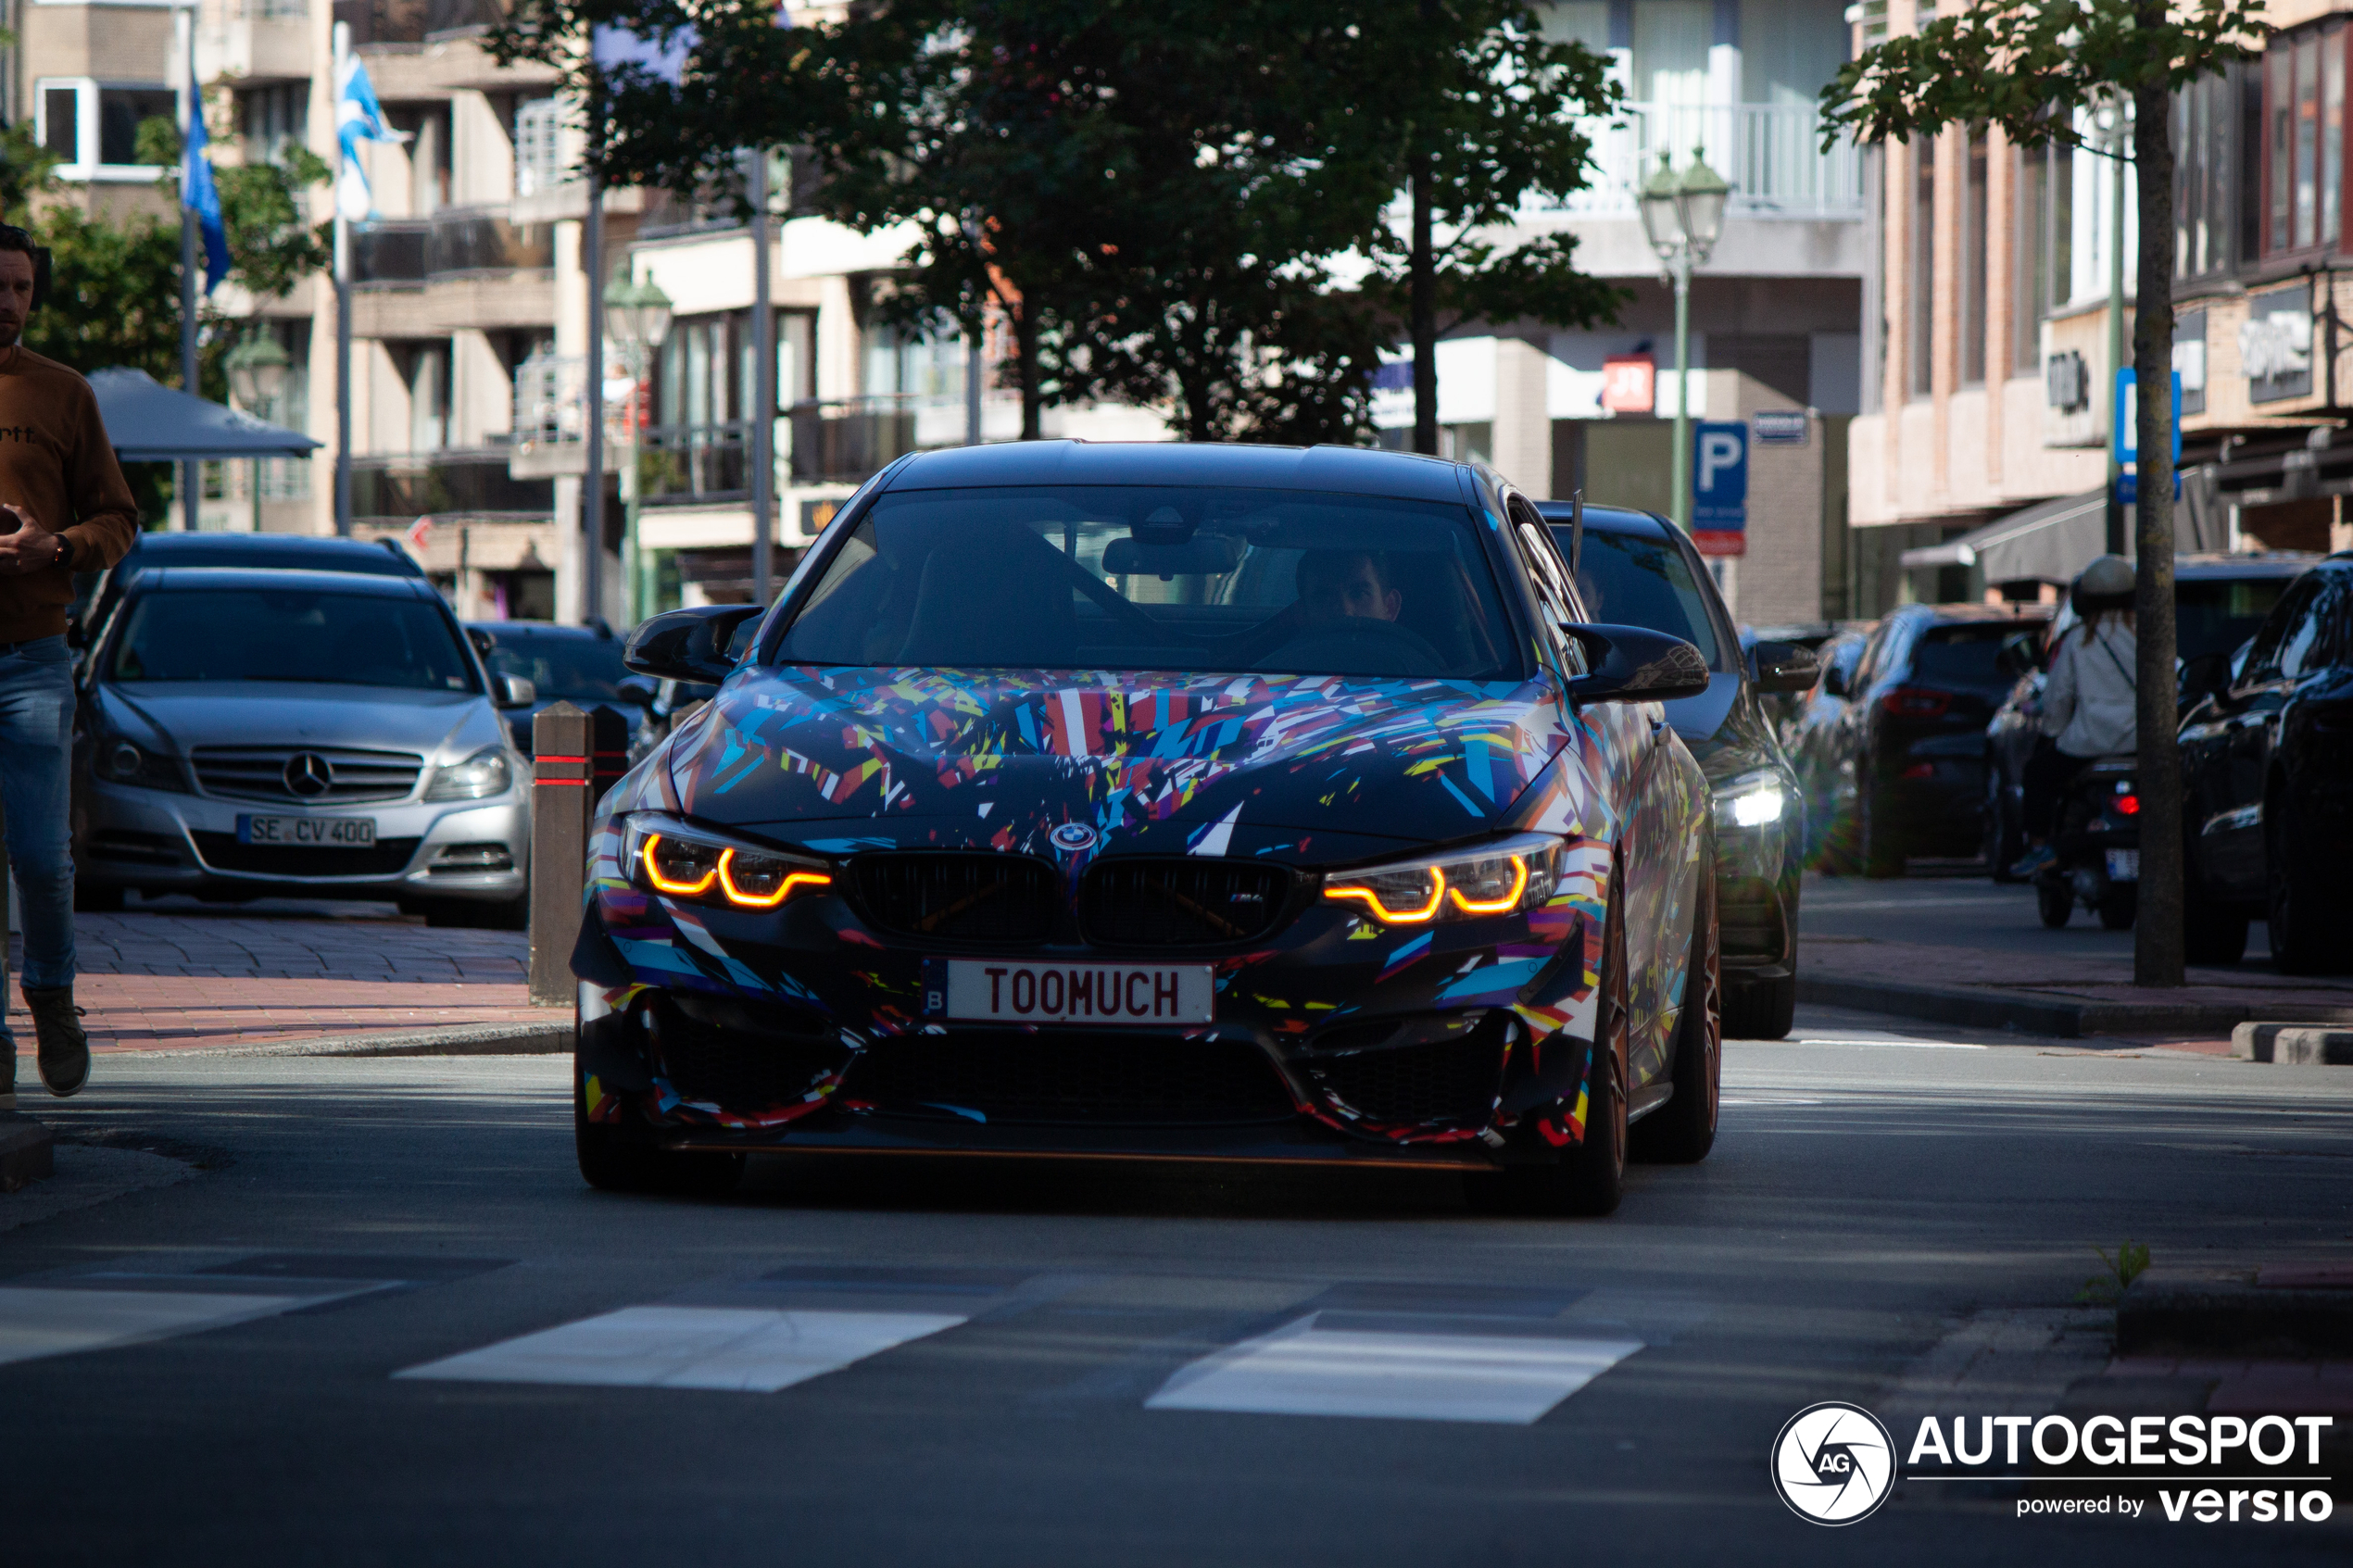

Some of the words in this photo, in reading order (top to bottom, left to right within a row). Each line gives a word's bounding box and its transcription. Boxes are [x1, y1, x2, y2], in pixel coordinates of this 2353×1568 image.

[1699, 432, 1743, 492] P
[252, 818, 280, 840] SE
[296, 820, 325, 841] CV
[331, 821, 371, 842] 400
[927, 991, 943, 1010] B
[985, 968, 1178, 1017] TOOMUCH
